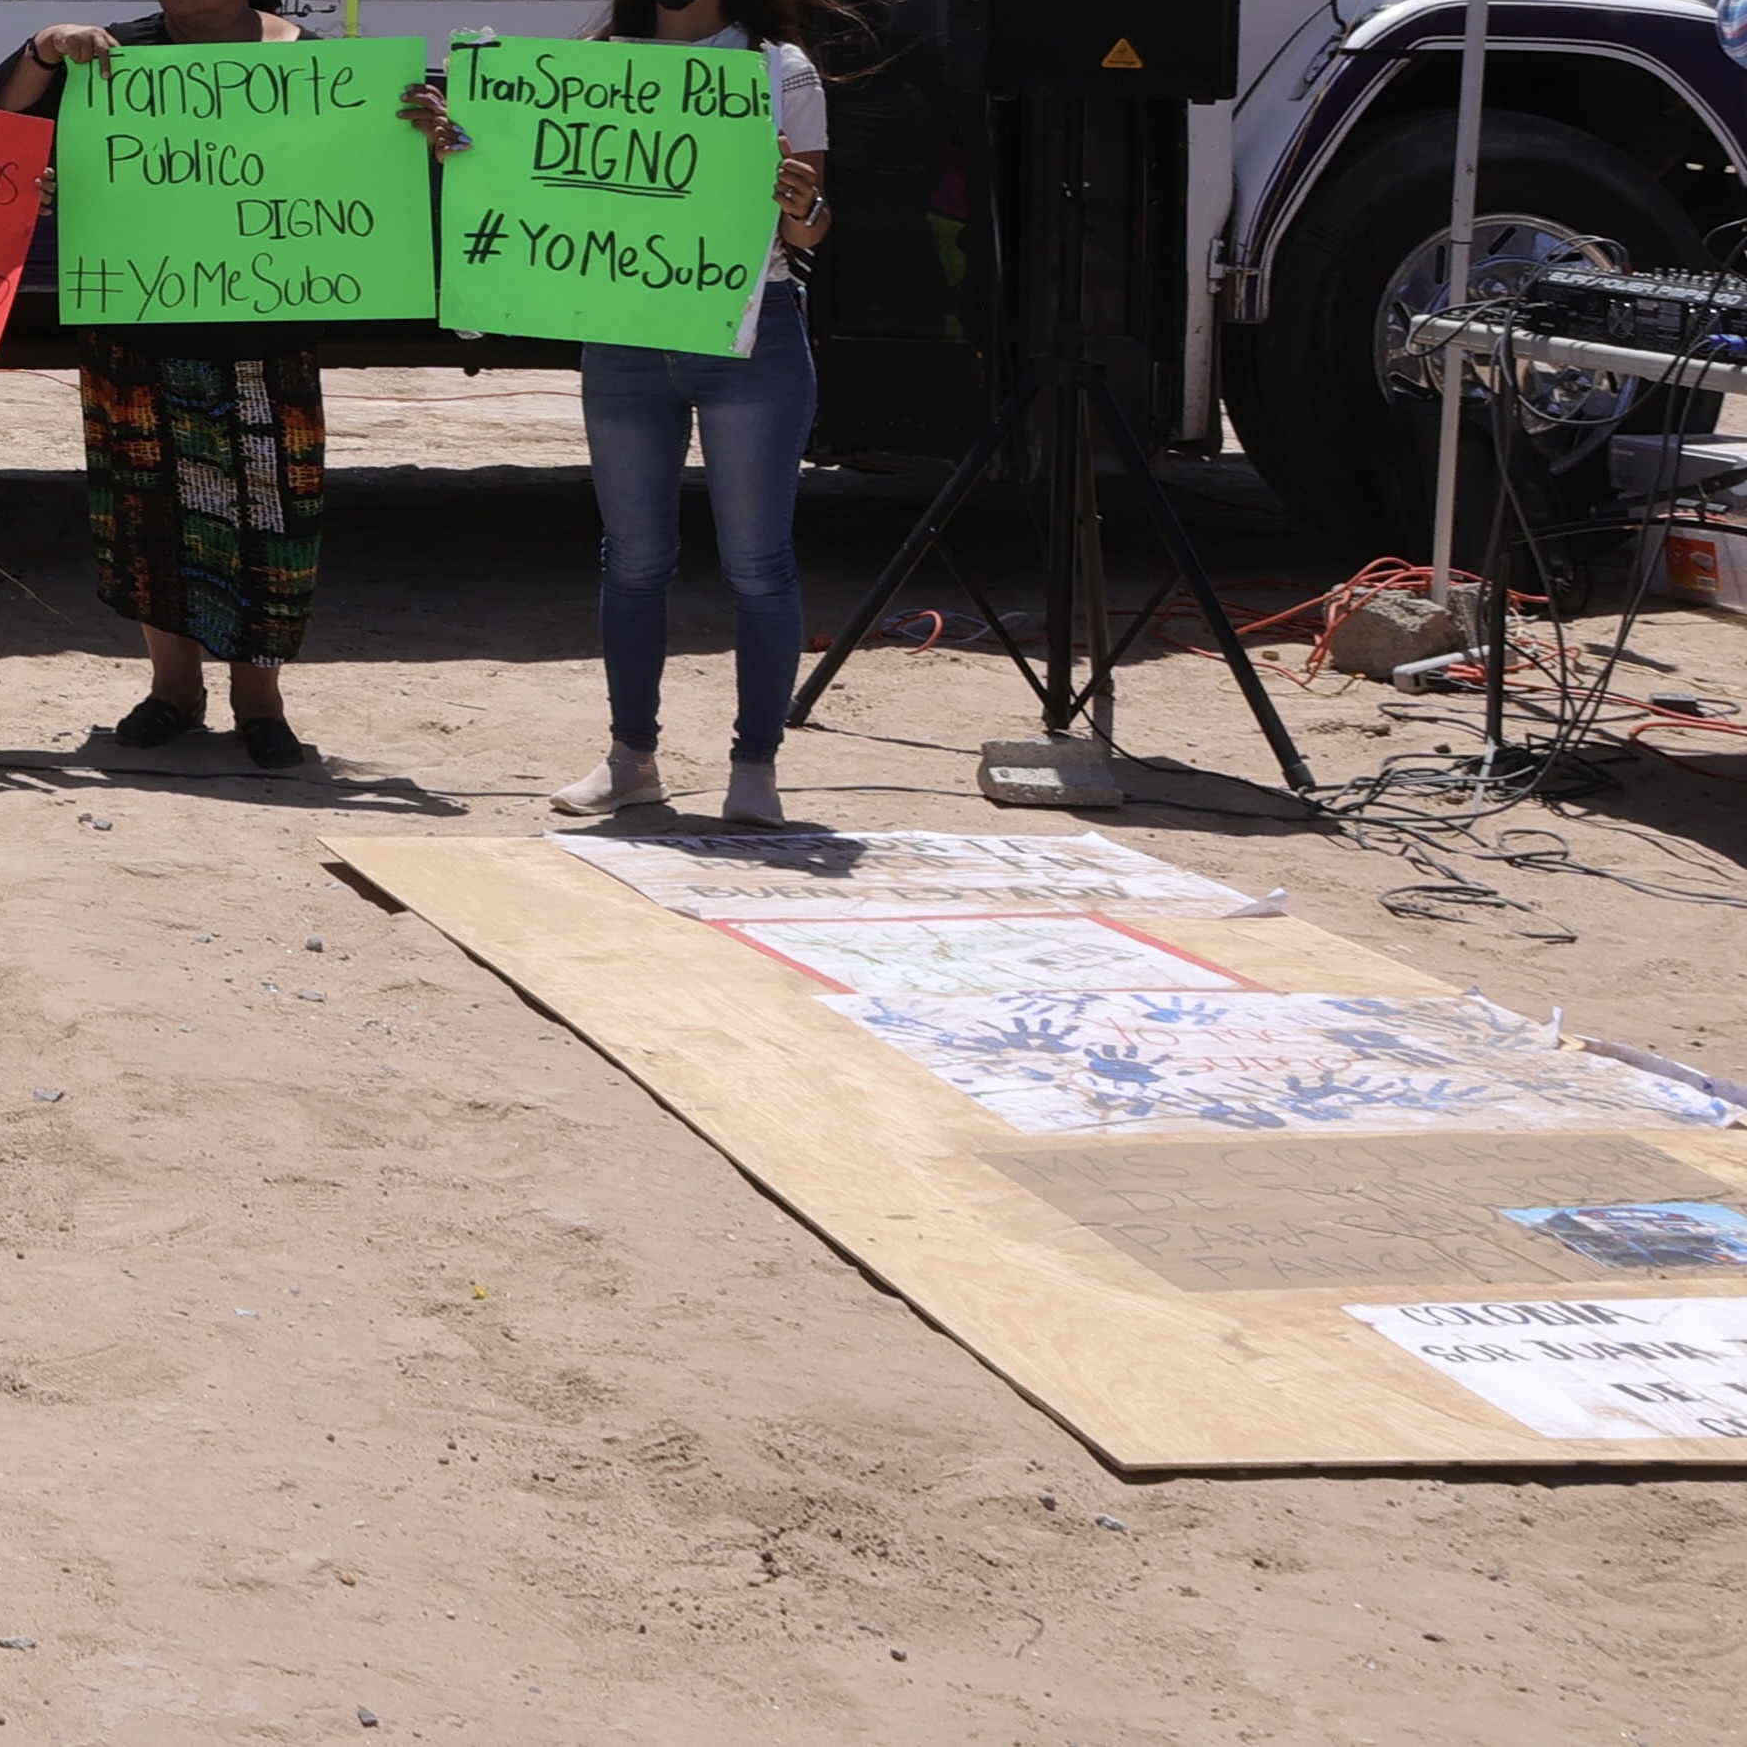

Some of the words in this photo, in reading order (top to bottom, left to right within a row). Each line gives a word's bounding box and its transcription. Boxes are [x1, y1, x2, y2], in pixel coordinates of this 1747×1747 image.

[681, 57, 771, 119] Públi
[106, 134, 265, 187] Público
[532, 117, 699, 191] DIGNO
[236, 198, 375, 240] DIGNO
[65, 252, 362, 322] #YoMeSubo
[1004, 854, 1107, 872] EN
[684, 885, 852, 900] BUEN
[1398, 1301, 1655, 1327] COLONIA
[1419, 1343, 1531, 1363] SOR
[1520, 1339, 1721, 1366] JUANA
[1607, 1381, 1707, 1403] DE
